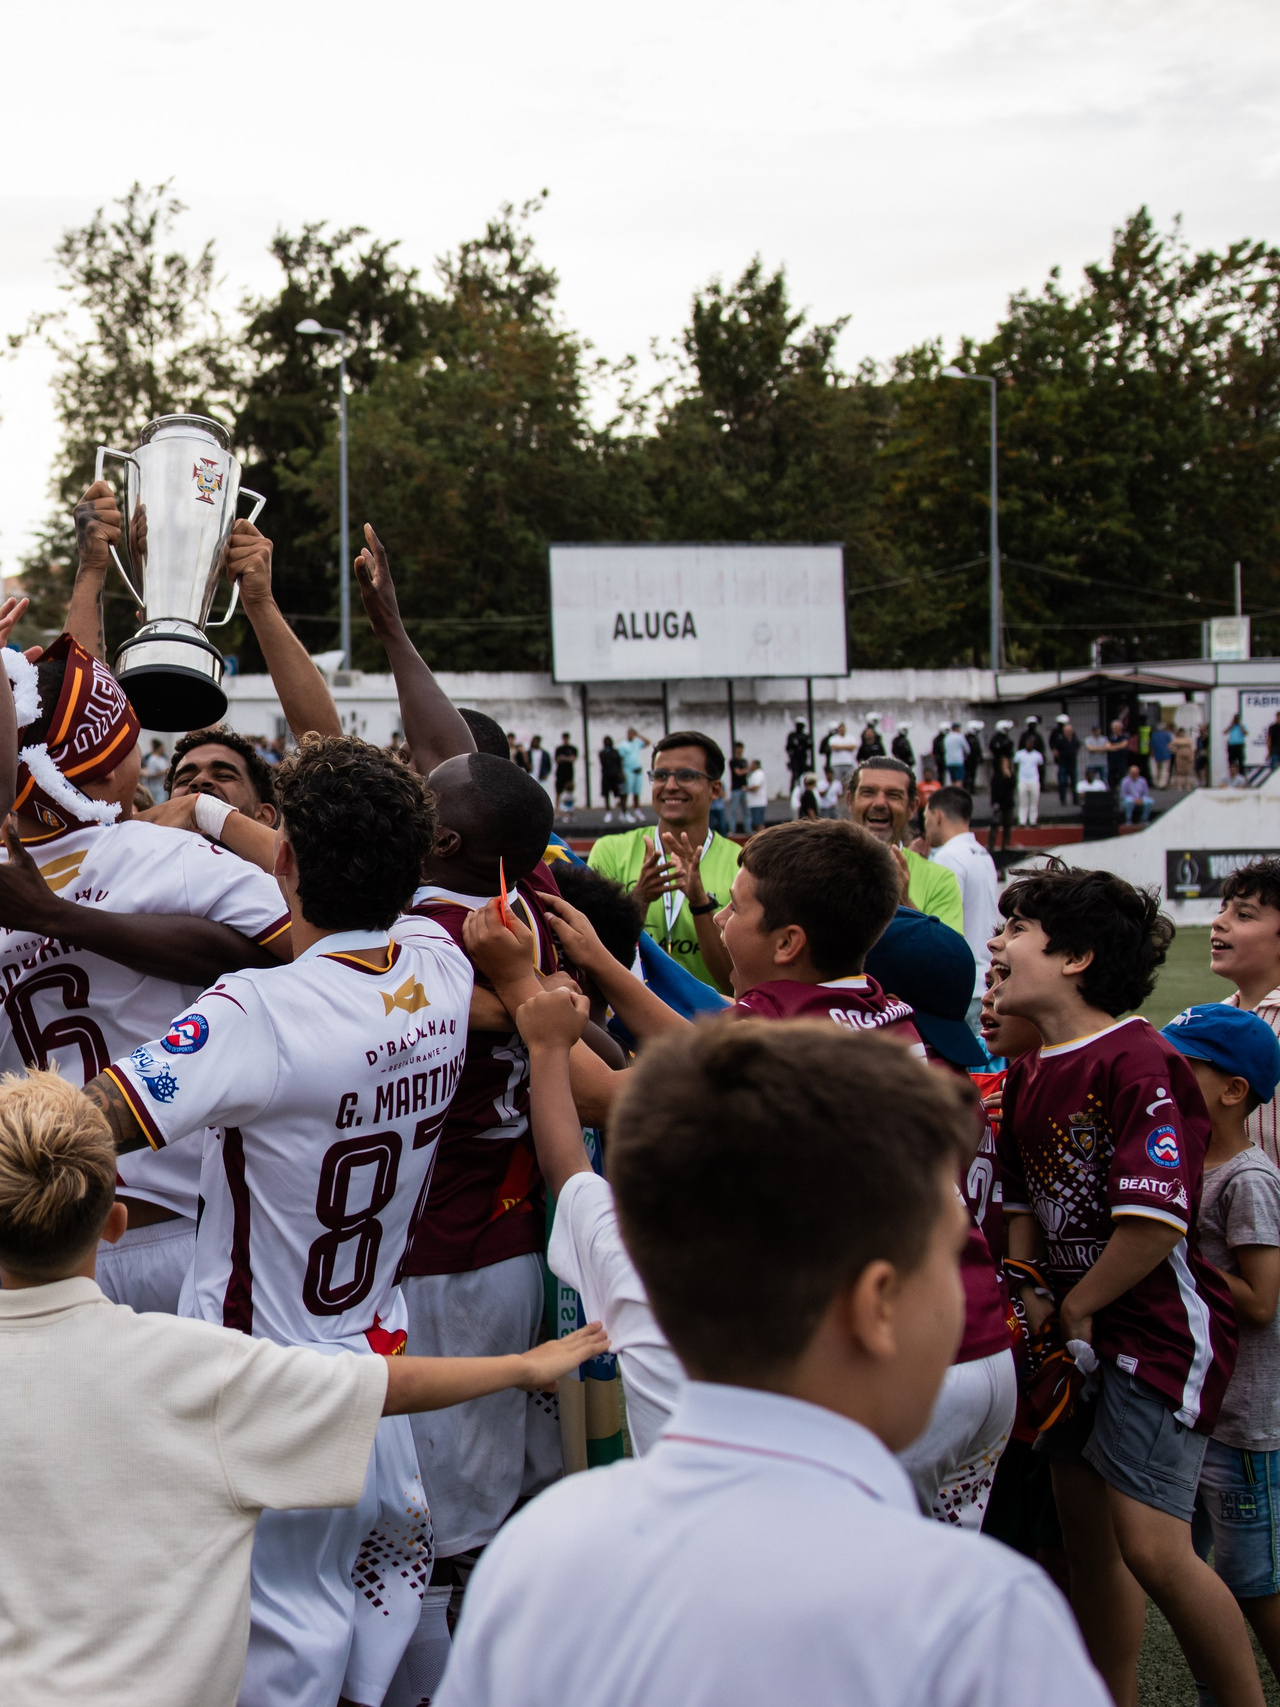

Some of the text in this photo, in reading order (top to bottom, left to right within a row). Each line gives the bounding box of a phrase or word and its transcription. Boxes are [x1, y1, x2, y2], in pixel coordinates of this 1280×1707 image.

[613, 610, 698, 641] ALUGA
[388, 1047, 441, 1073] RESTAURANTE
[335, 1092, 363, 1130] G.
[1119, 1178, 1168, 1196] BEATO
